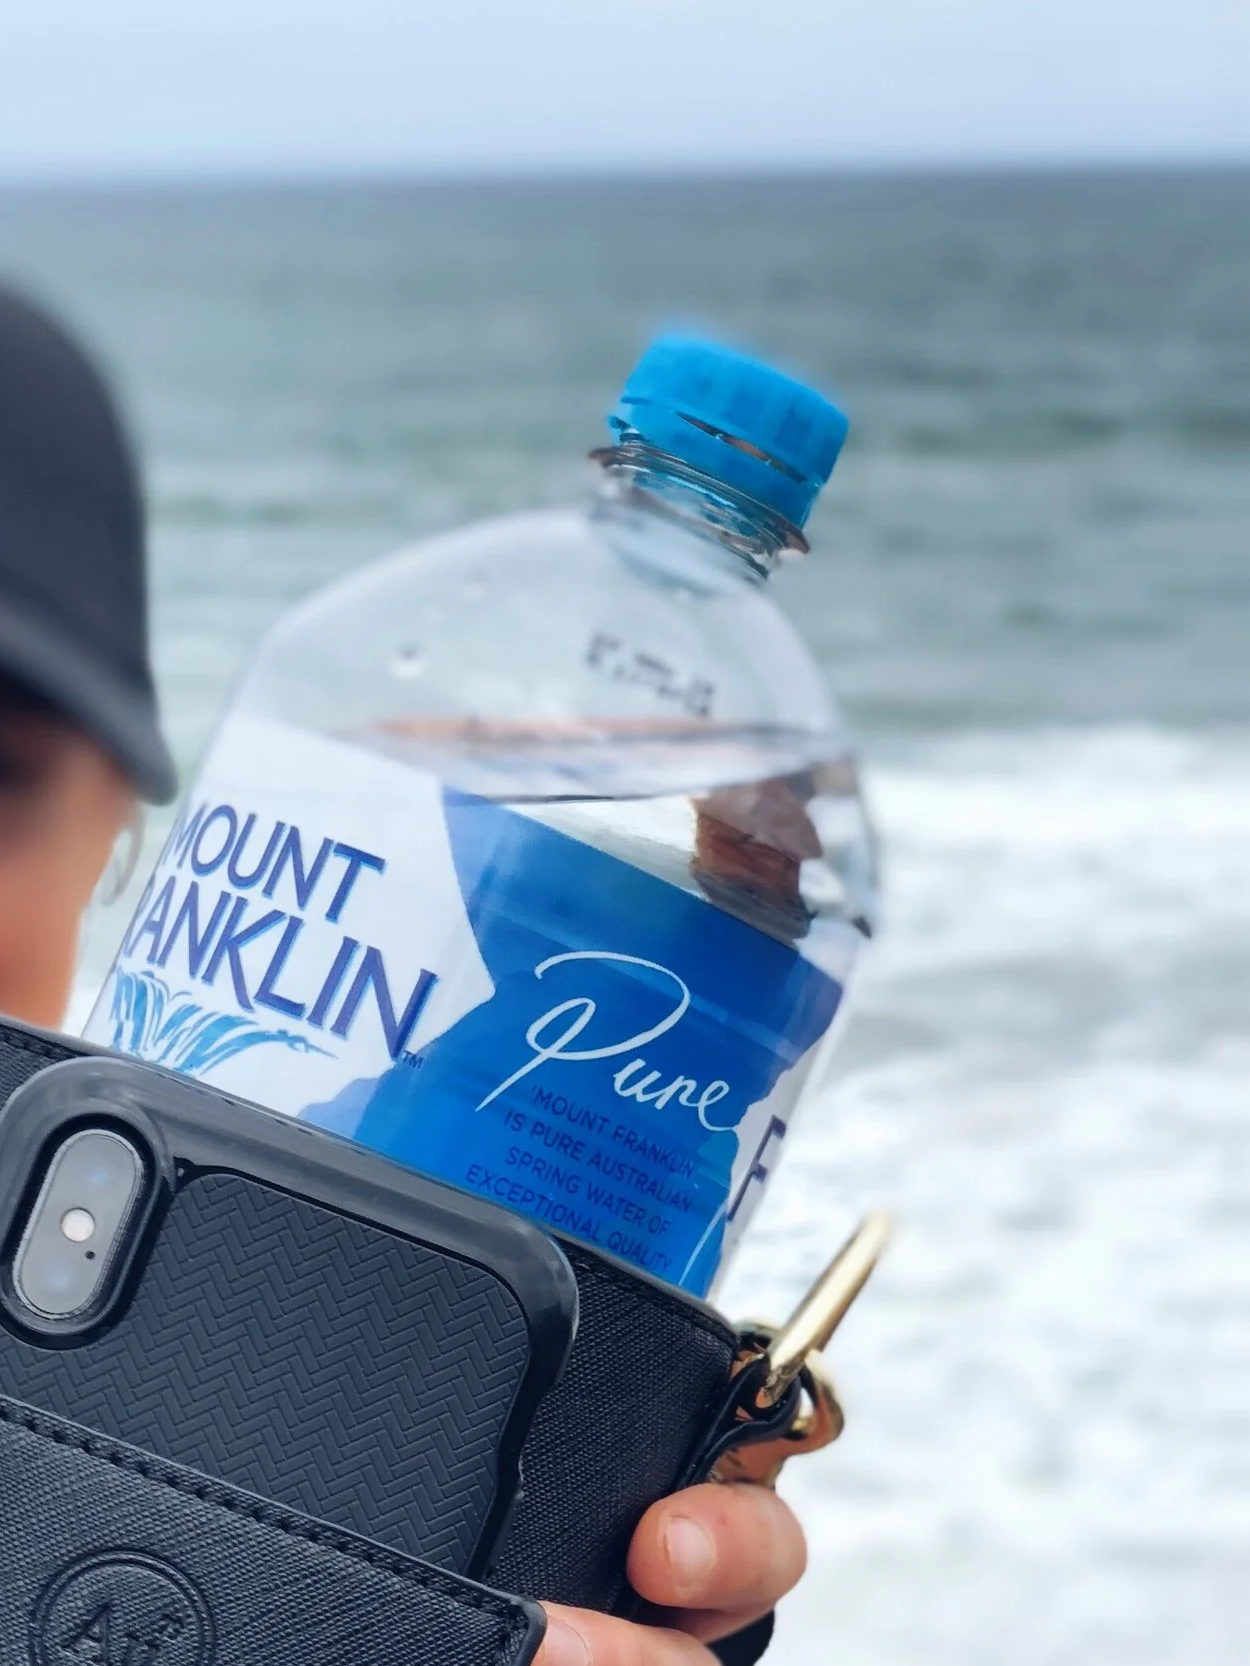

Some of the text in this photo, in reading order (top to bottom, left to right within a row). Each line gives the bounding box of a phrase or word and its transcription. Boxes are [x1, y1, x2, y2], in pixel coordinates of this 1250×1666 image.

[161, 798, 387, 924] MOUNT
[475, 950, 736, 1132] Pure
[503, 1108, 692, 1213] IS PURE AUSTRALIAN
[505, 1146, 672, 1236] SPRING WATER OF
[465, 1164, 674, 1273] EXCEPTIONAL QUALITY
